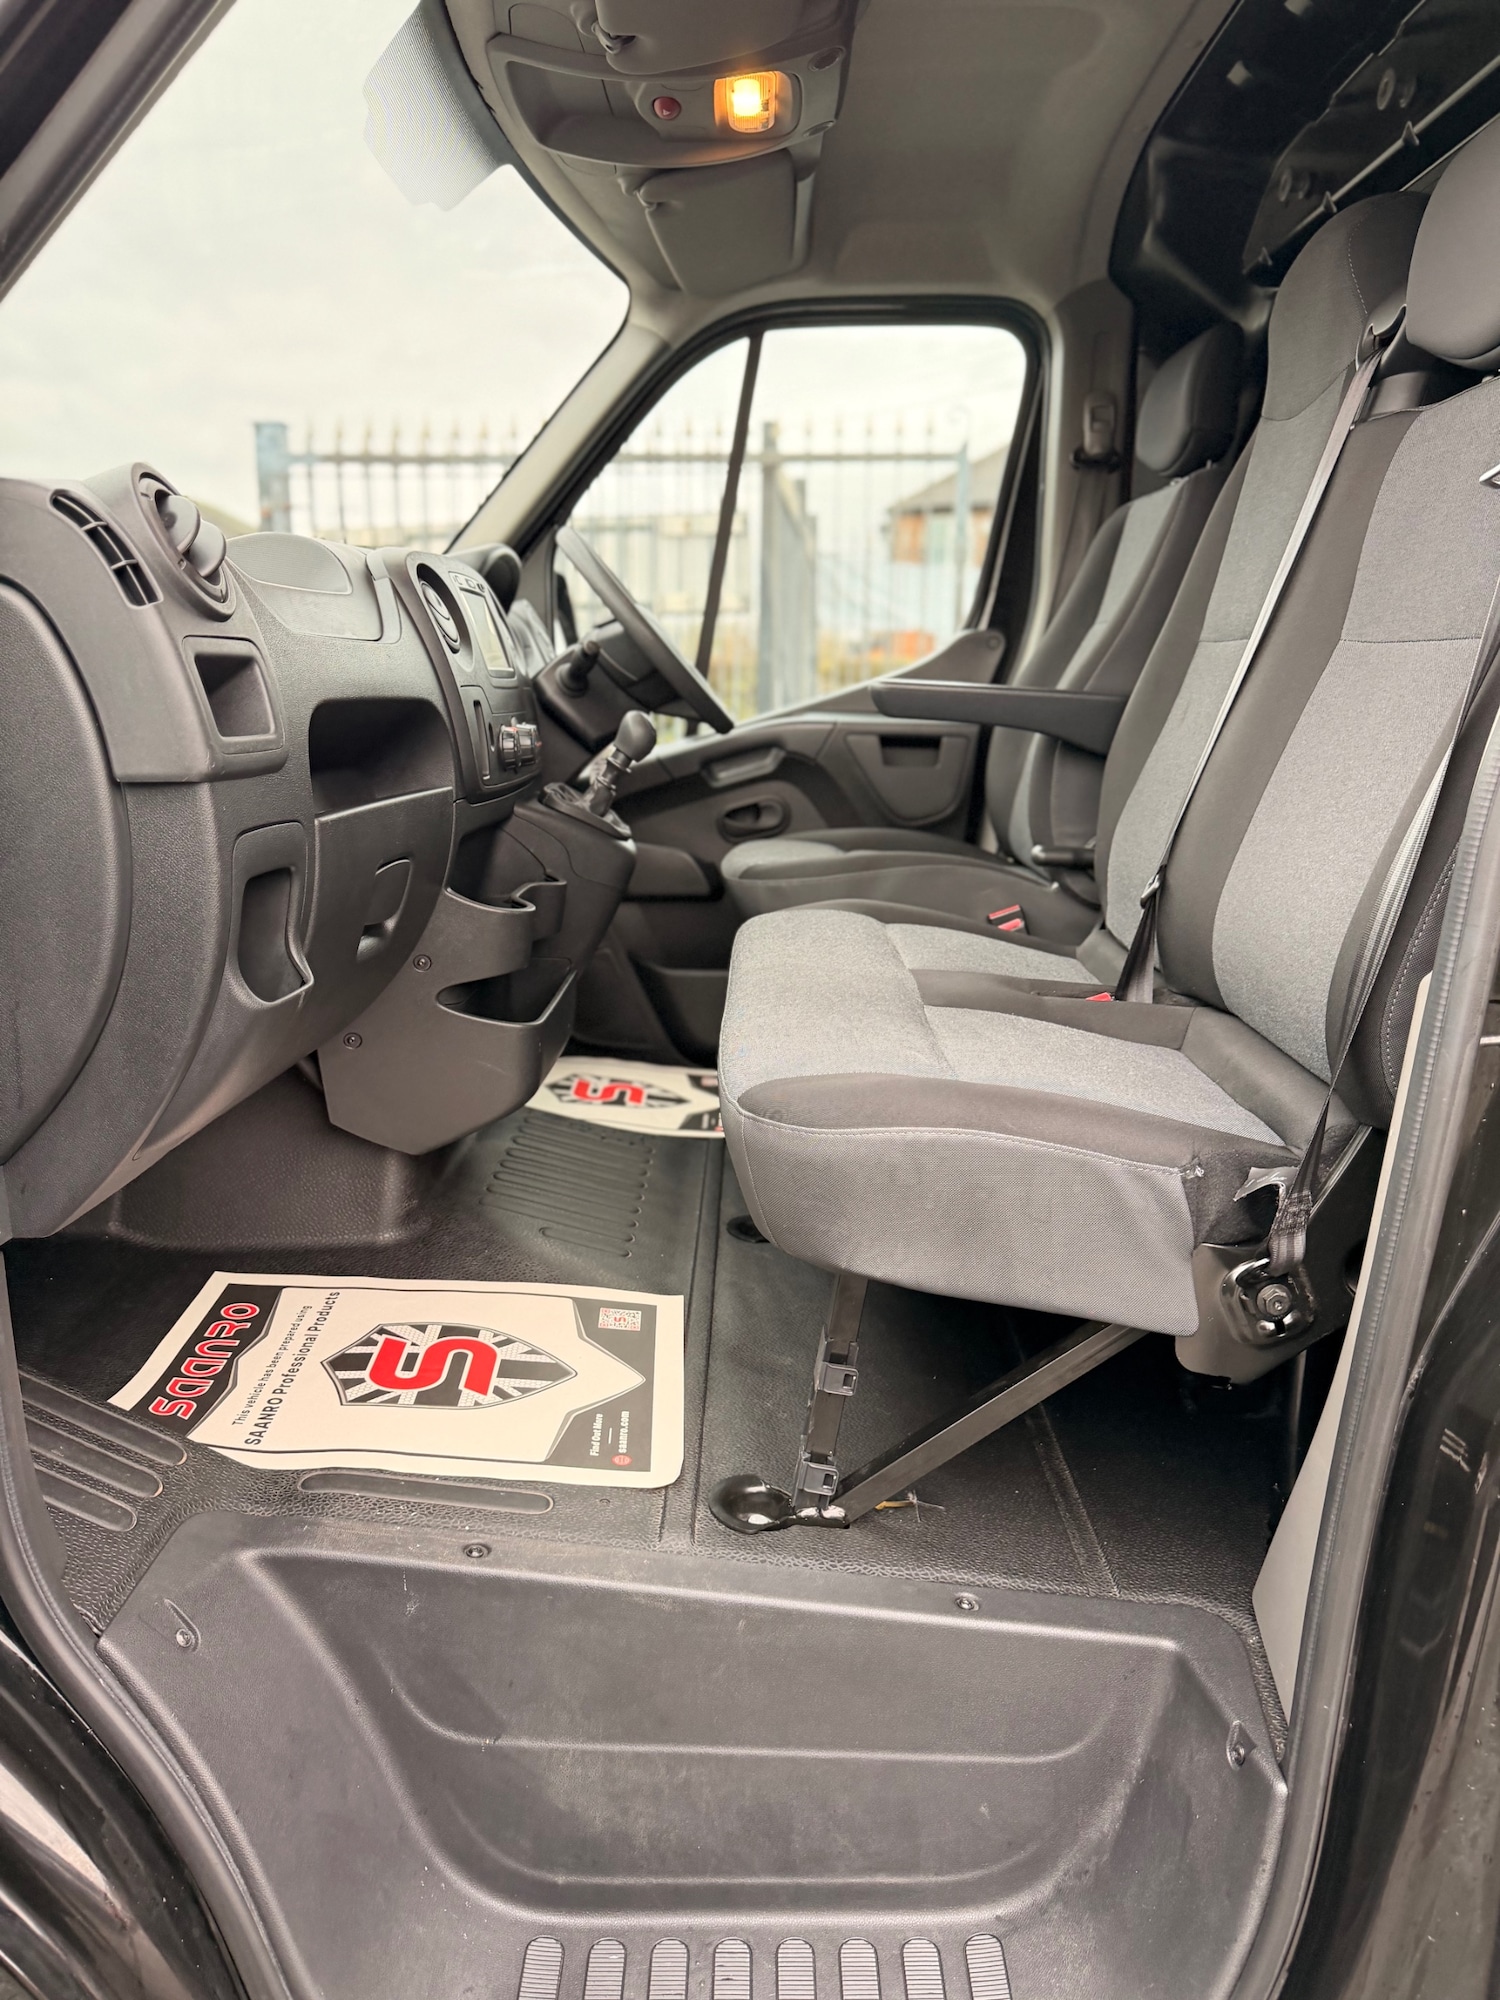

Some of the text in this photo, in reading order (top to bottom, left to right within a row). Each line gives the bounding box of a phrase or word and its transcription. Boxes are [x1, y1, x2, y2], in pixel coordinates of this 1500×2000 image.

[232, 1305, 313, 1426] This vehicle has been prepared using
[244, 1291, 341, 1446] SAANRO Professional Products
[589, 1413, 604, 1457] Find Out More
[618, 1410, 630, 1454] saanro.com
